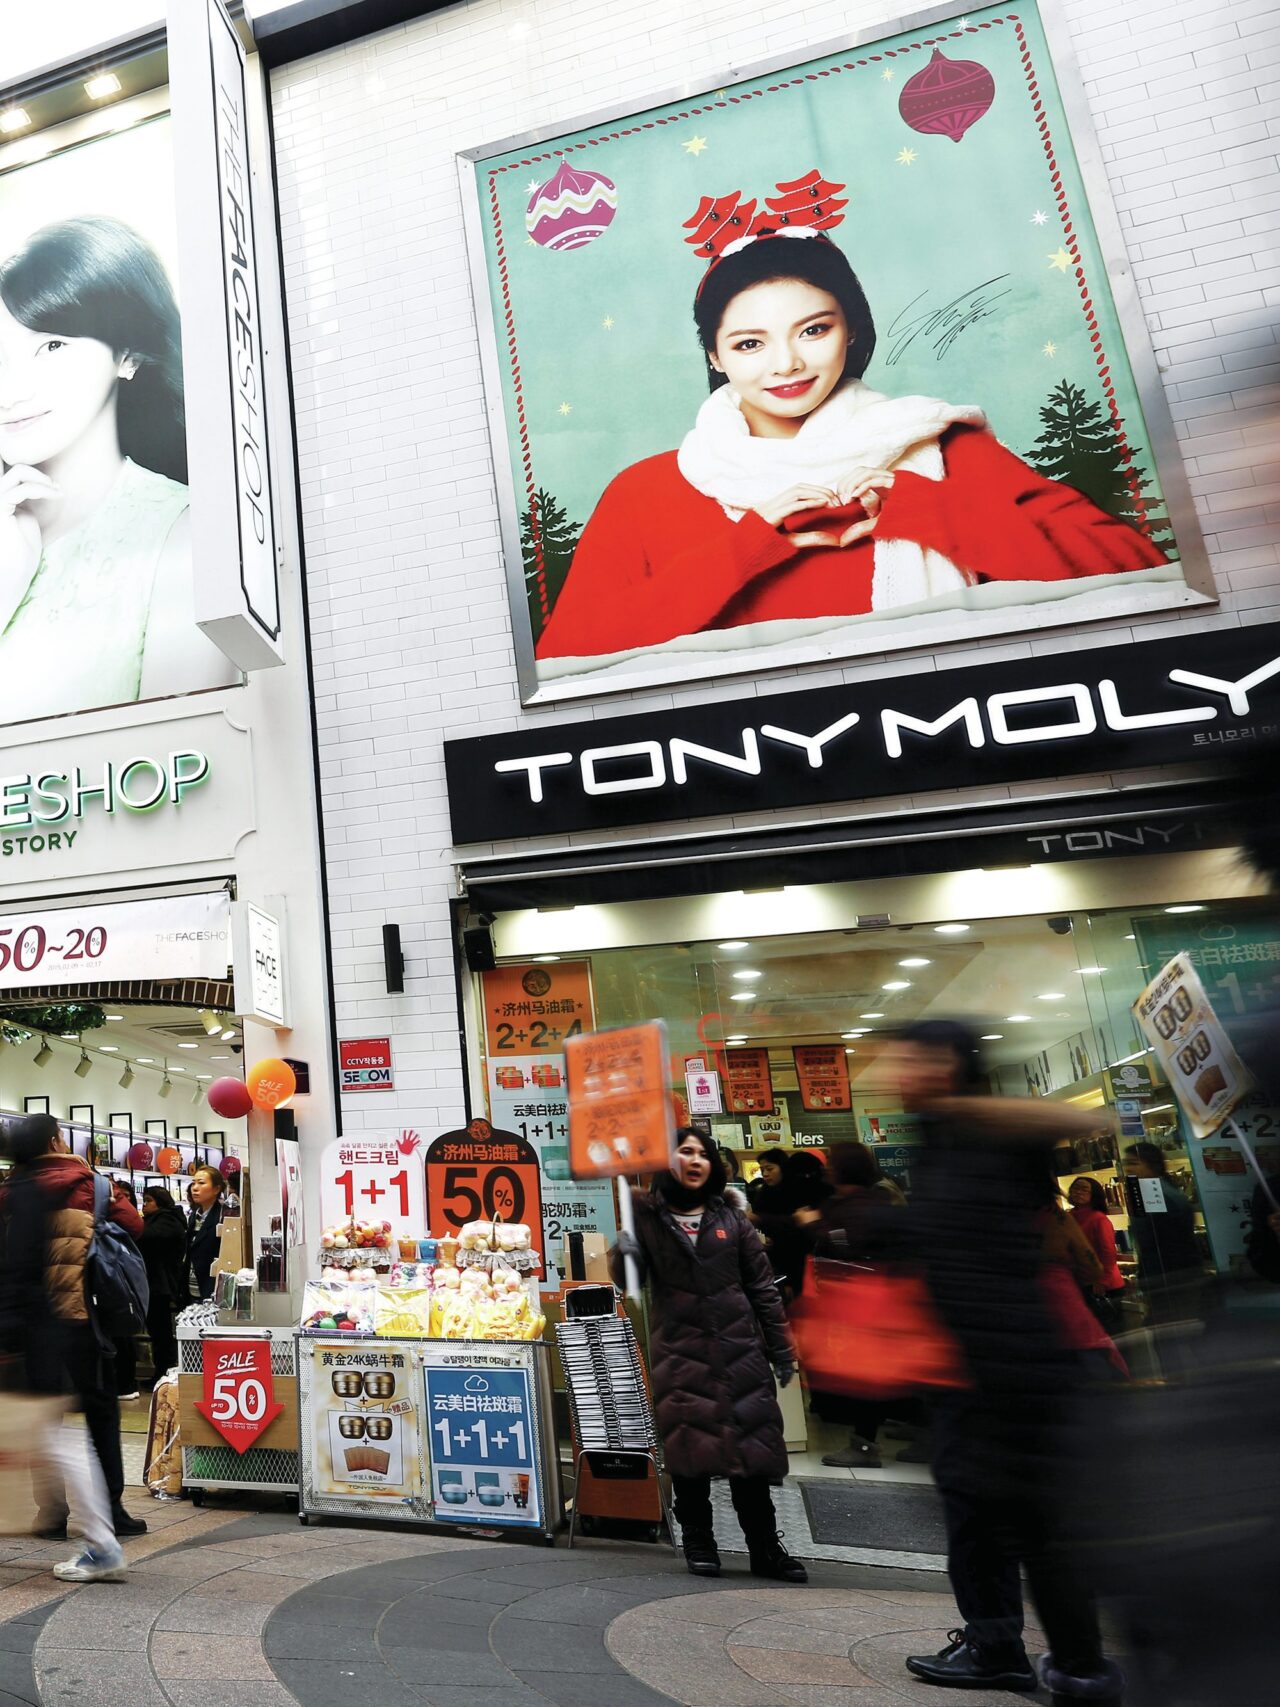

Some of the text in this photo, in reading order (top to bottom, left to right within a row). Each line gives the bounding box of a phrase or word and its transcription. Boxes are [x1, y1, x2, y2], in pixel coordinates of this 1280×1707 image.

[1192, 727, 1257, 747] 토니모리
[2, 830, 78, 857] STORY
[255, 949, 277, 980] FACE
[502, 998, 575, 1017] 济州马油霜
[343, 1069, 390, 1083] SECOM
[258, 1079, 284, 1092] SALE
[256, 1088, 280, 1105] 50
[513, 1103, 568, 1117] 云美白祛斑
[518, 1121, 569, 1140] 1+1+
[338, 1150, 399, 1166] 핸드크림
[443, 1144, 519, 1162] 济州马油霜
[335, 1170, 410, 1217] 1+1
[542, 1202, 587, 1218] 驼奶霜
[217, 1350, 256, 1370] SALE
[322, 1353, 405, 1368] 黄金24K蜗牛霜
[391, 1402, 411, 1414] 赠品
[433, 1394, 523, 1414] 云美白祛斑霜
[434, 1417, 527, 1460] 1+1+1
